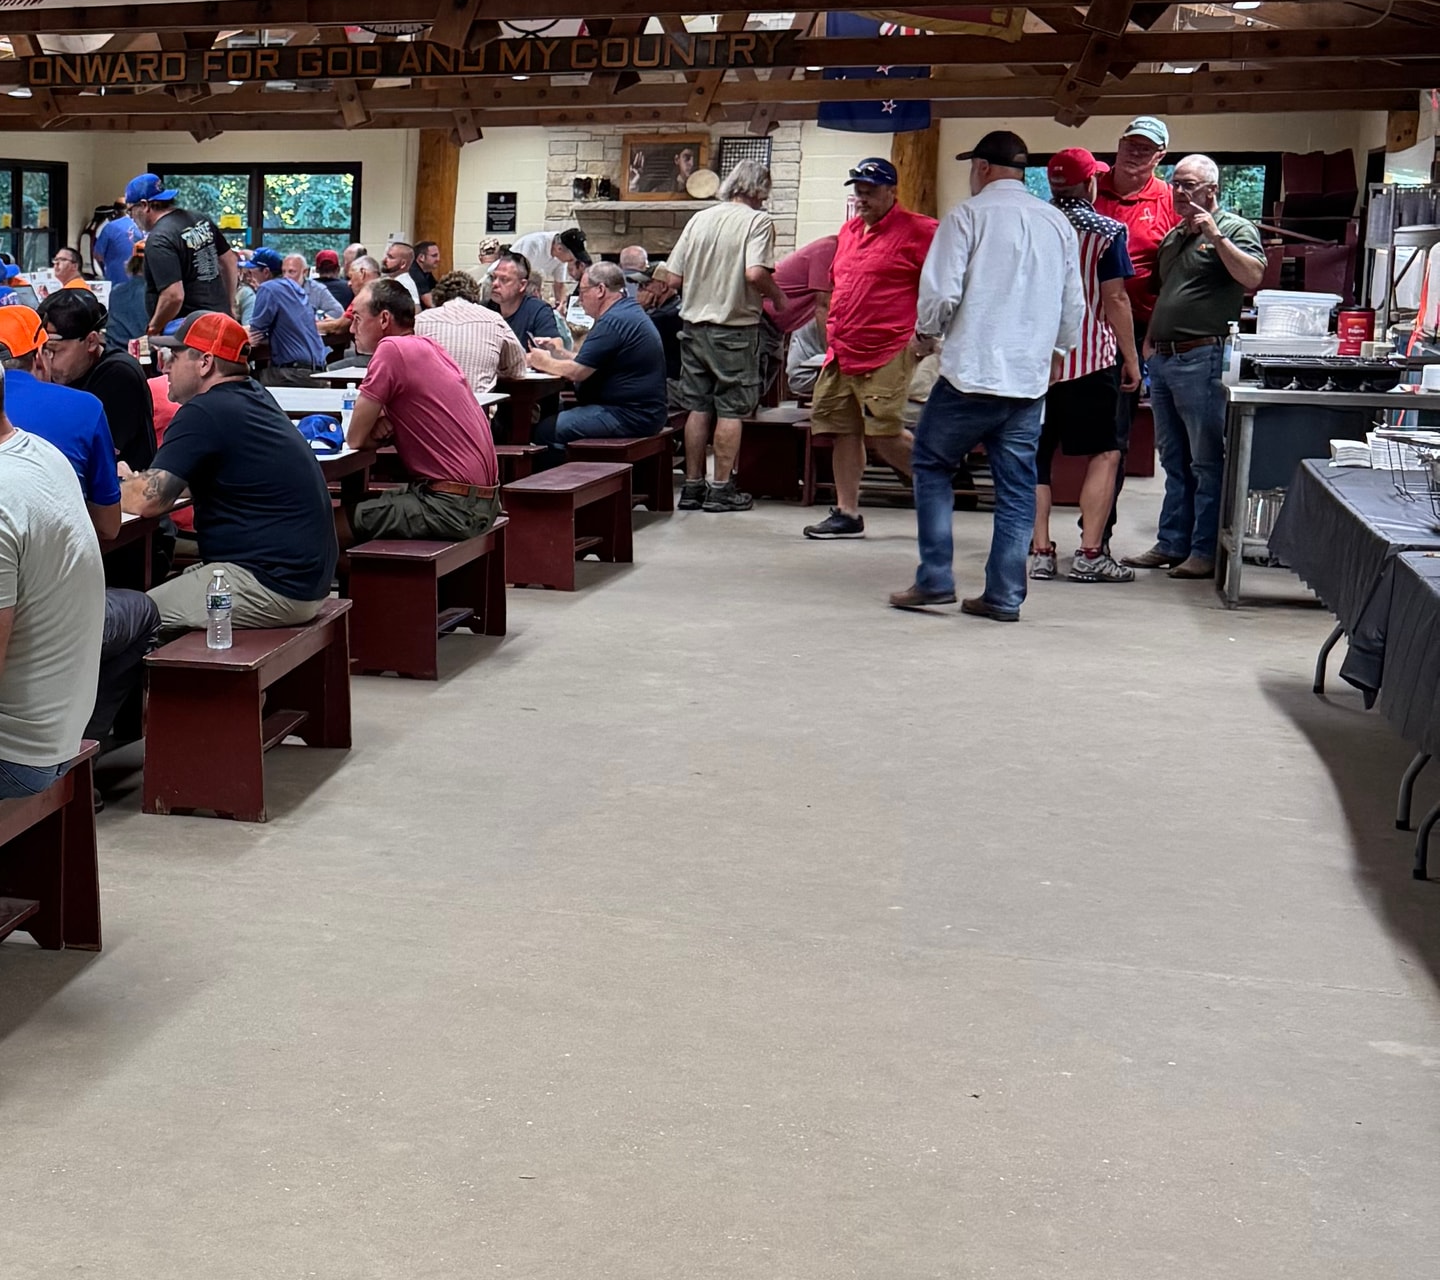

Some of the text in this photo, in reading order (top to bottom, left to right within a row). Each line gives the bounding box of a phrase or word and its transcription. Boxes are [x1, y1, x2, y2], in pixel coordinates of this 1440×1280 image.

[28, 33, 785, 85] ONWARD FOR GOD AND MY COUNTRY
